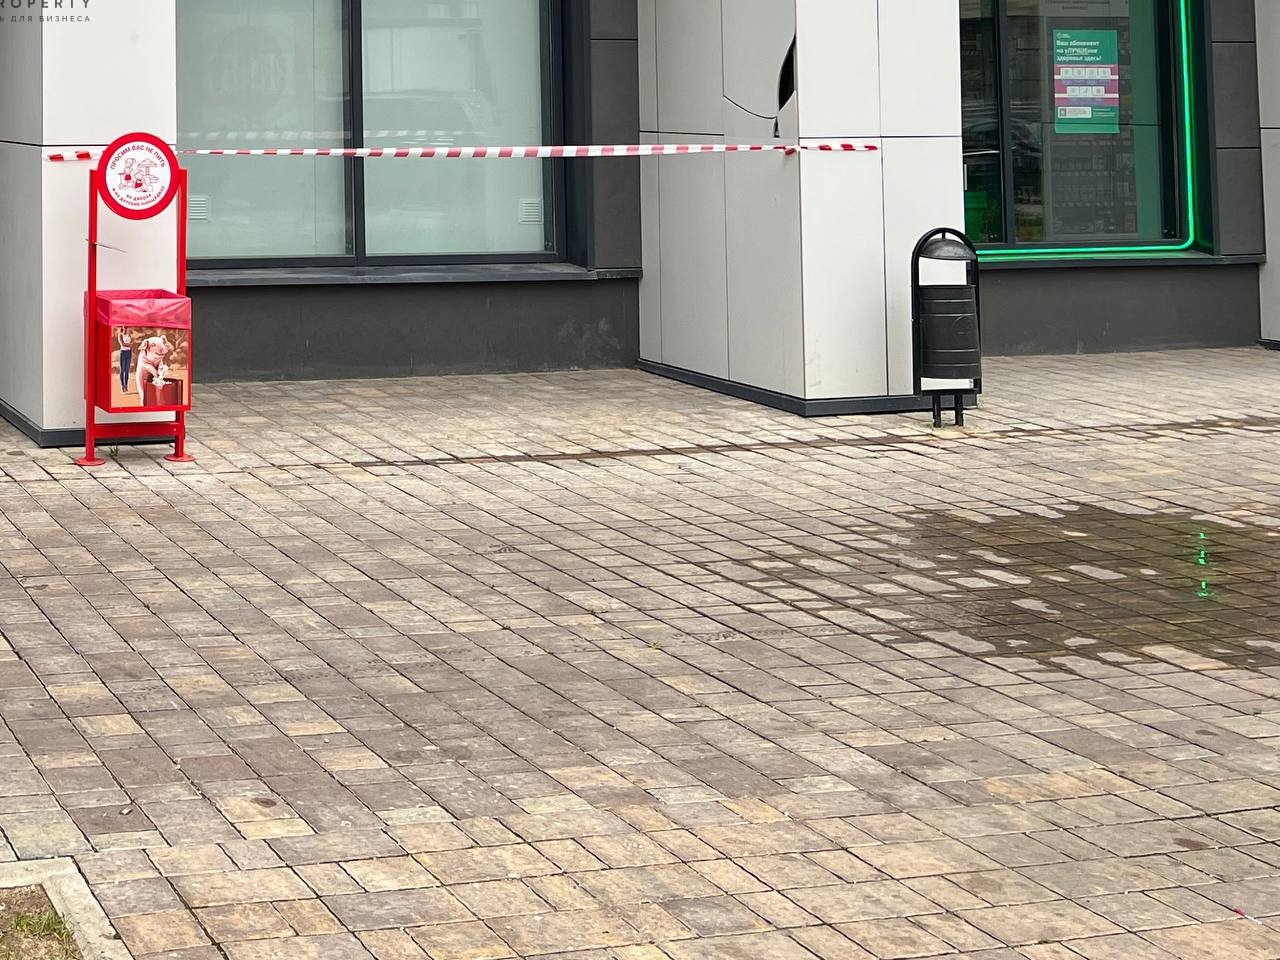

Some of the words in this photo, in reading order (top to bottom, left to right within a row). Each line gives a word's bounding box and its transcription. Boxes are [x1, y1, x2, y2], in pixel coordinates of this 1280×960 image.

[110, 147, 131, 170] ПРОСИМ
[145, 146, 154, 154] НЕ
[153, 151, 166, 168] ПИТЬ
